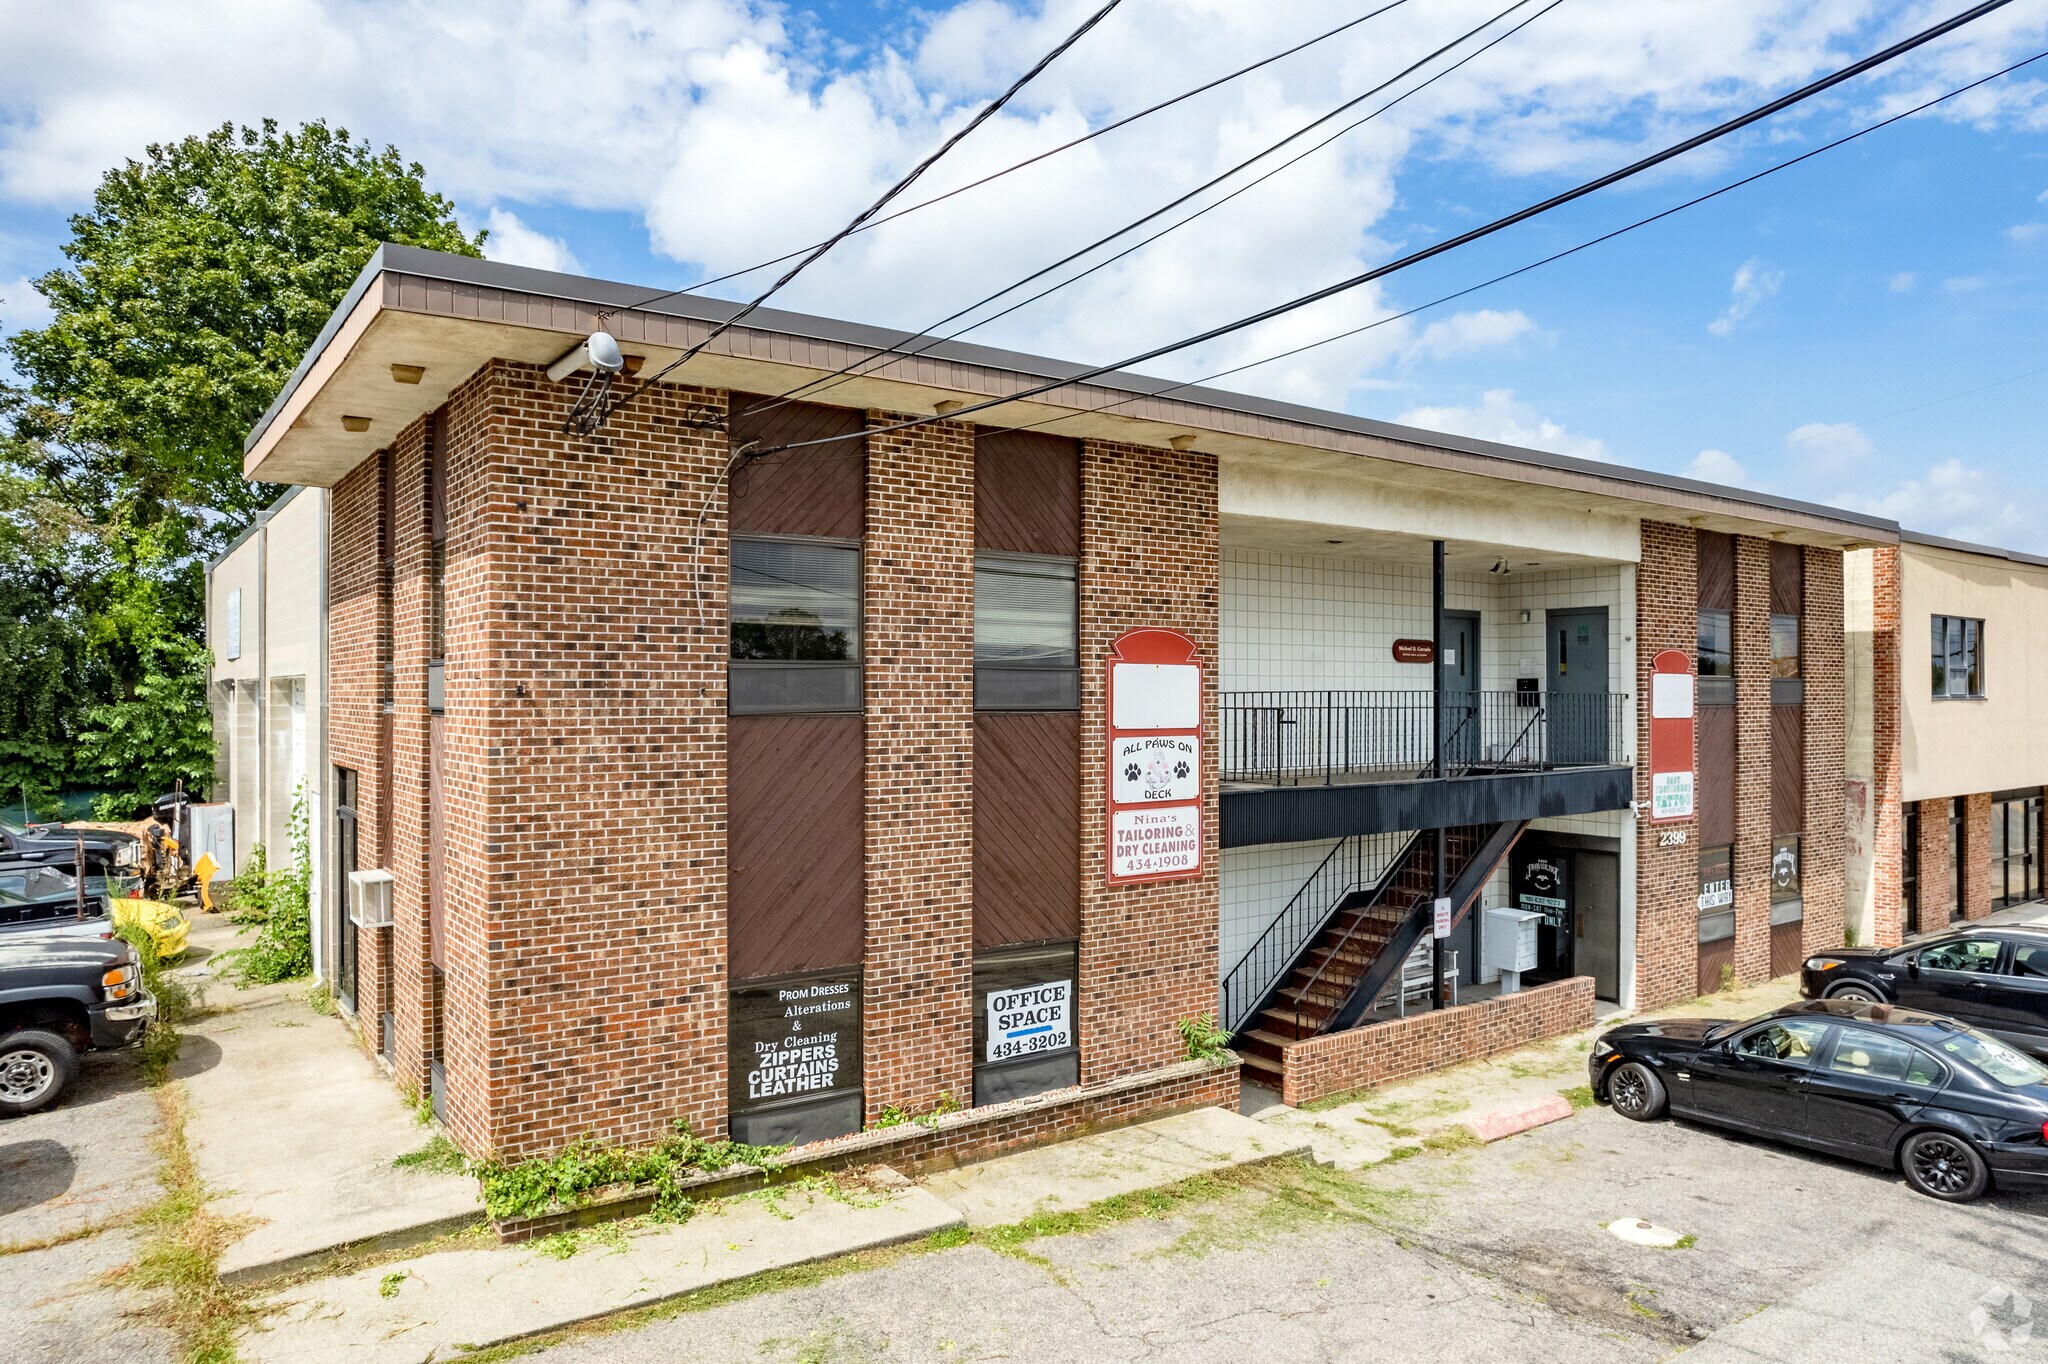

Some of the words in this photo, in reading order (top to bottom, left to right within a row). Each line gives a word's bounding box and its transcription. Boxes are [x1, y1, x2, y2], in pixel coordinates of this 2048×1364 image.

[1123, 741, 1142, 756] ALL
[1145, 739, 1176, 750] PAWS
[1178, 741, 1193, 754] ON
[1144, 789, 1172, 800] DECK
[1133, 814, 1178, 825] Nina's
[1117, 825, 1183, 843] TAILORING
[1184, 823, 1196, 837] &
[1116, 844, 1139, 858] DRY
[1142, 839, 1196, 856] CLEANING
[1704, 879, 1731, 896] ENTER
[1700, 894, 1715, 908] THIS
[1544, 915, 1562, 928] ONLY
[779, 988, 809, 1002] PROM
[810, 983, 849, 998] DRESSES
[993, 985, 1066, 1013] OFFICE
[784, 999, 851, 1018] Alterations
[998, 1005, 1062, 1031] SPACE
[792, 1020, 802, 1032] &
[754, 1039, 778, 1055] Dry
[784, 1031, 838, 1049] Cleaning
[992, 1032, 1067, 1059] 434-3202
[760, 1044, 836, 1069] ZIPPERS
[748, 1057, 839, 1086] CURTAINS
[750, 1072, 834, 1100] LEATHER
